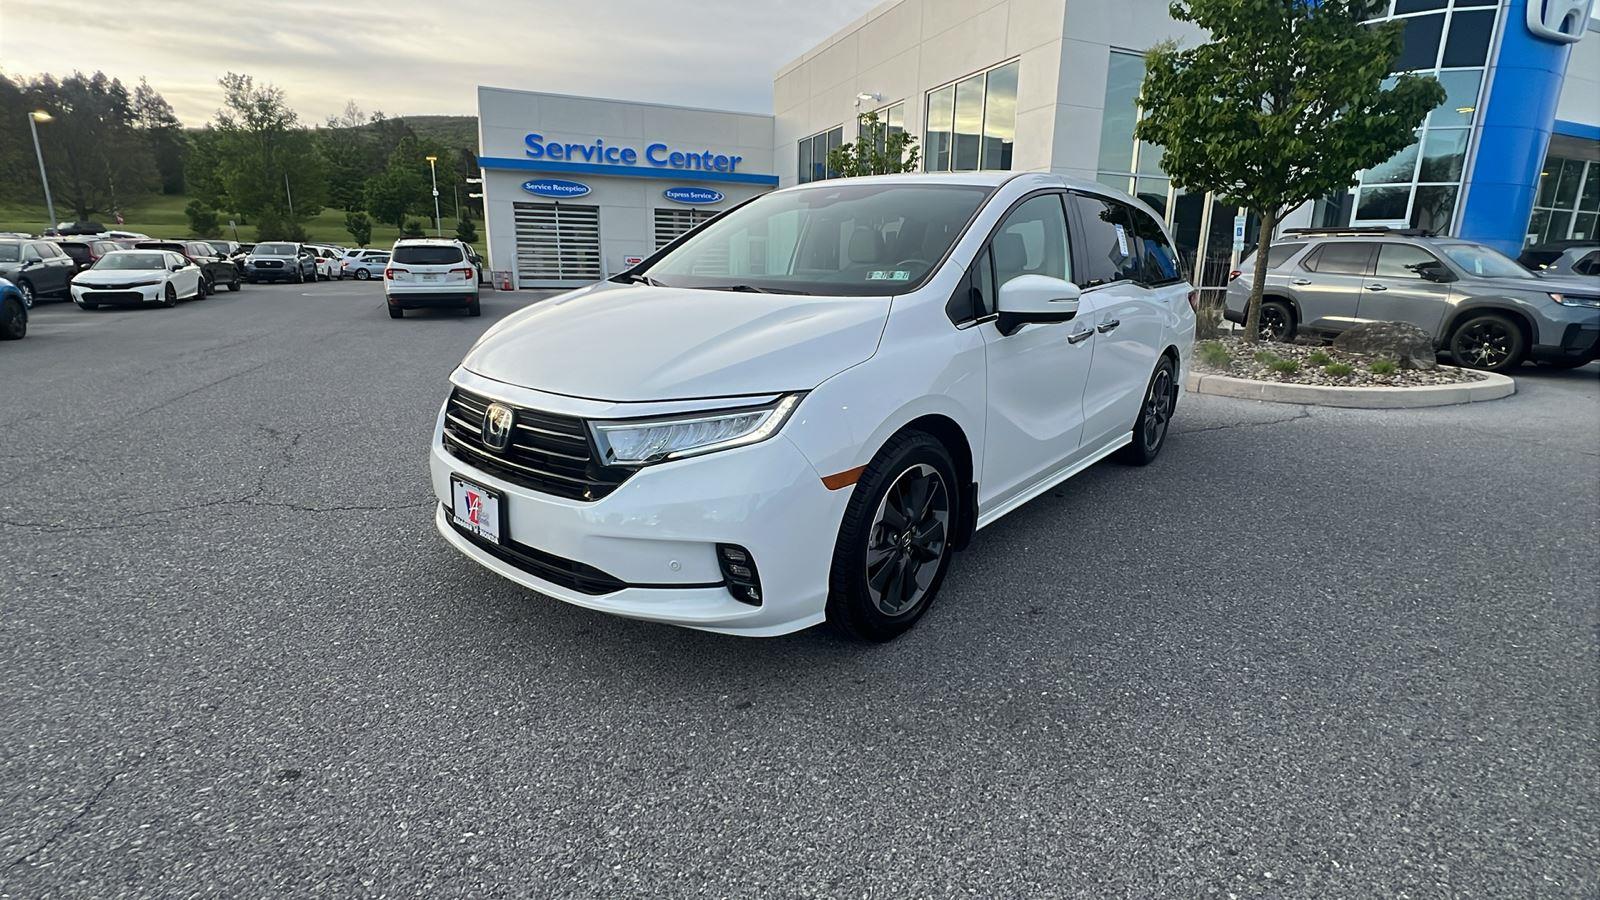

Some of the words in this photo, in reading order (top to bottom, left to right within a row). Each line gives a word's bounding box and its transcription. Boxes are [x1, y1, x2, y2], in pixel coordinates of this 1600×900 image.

[524, 133, 637, 165] Service
[646, 143, 742, 172] Center
[525, 182, 552, 191] Service
[552, 184, 587, 193] Reception
[666, 190, 690, 199] Express
[690, 191, 712, 200] Service
